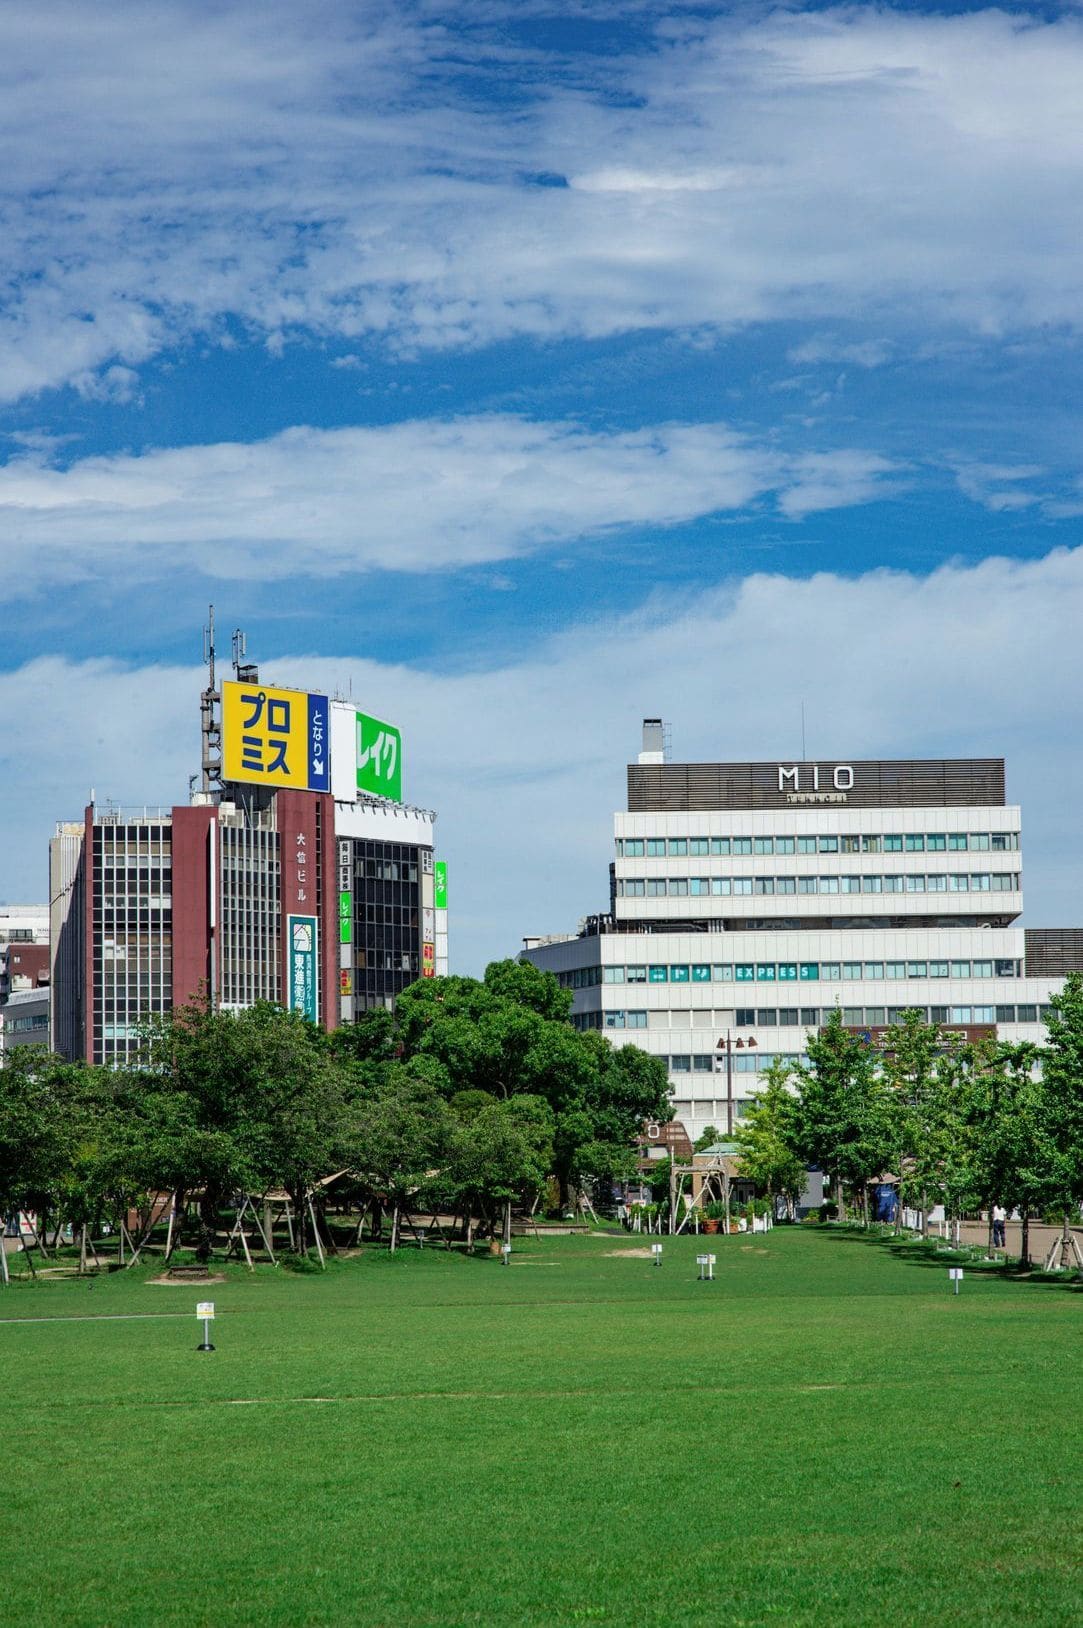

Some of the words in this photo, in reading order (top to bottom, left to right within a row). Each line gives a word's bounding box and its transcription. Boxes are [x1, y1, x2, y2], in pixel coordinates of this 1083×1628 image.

[240, 691, 290, 734] プロ
[312, 710, 323, 757] となり
[241, 735, 291, 775] ミス
[357, 720, 397, 781] レイク
[778, 766, 854, 791] MIO
[296, 832, 306, 901] 大信ビル
[736, 966, 809, 978] EXPRESS
